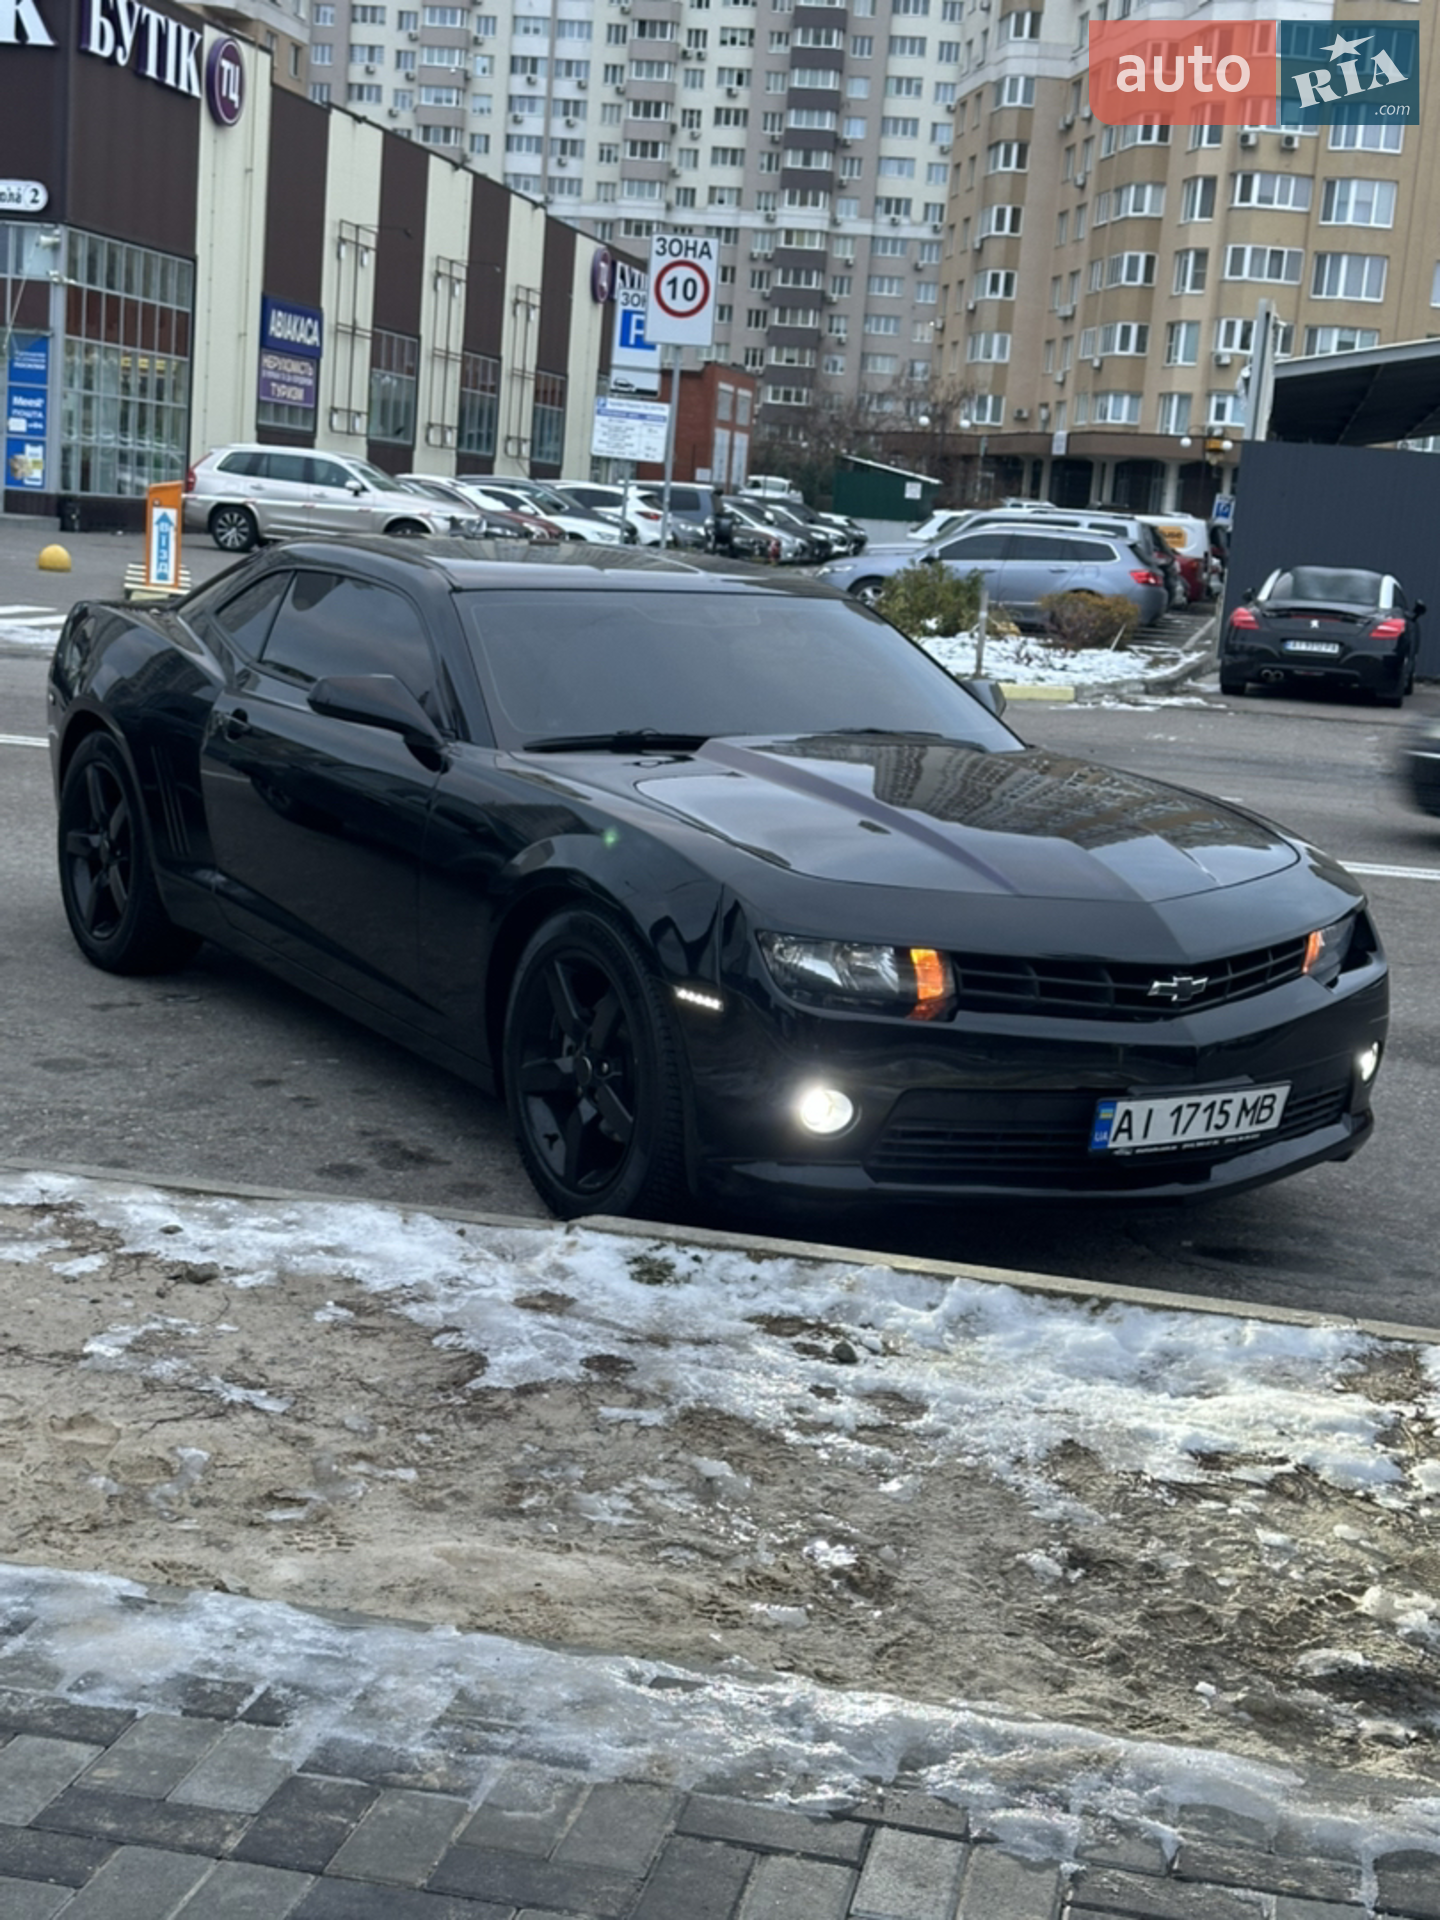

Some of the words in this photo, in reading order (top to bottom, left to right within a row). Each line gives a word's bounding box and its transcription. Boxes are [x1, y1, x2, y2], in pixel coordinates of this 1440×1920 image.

[88, 0, 203, 98] БУТІК
[29, 188, 40, 204] 2
[655, 236, 713, 260] ЗОНА
[666, 276, 698, 302] 10
[268, 308, 320, 347] АВІАКАСА
